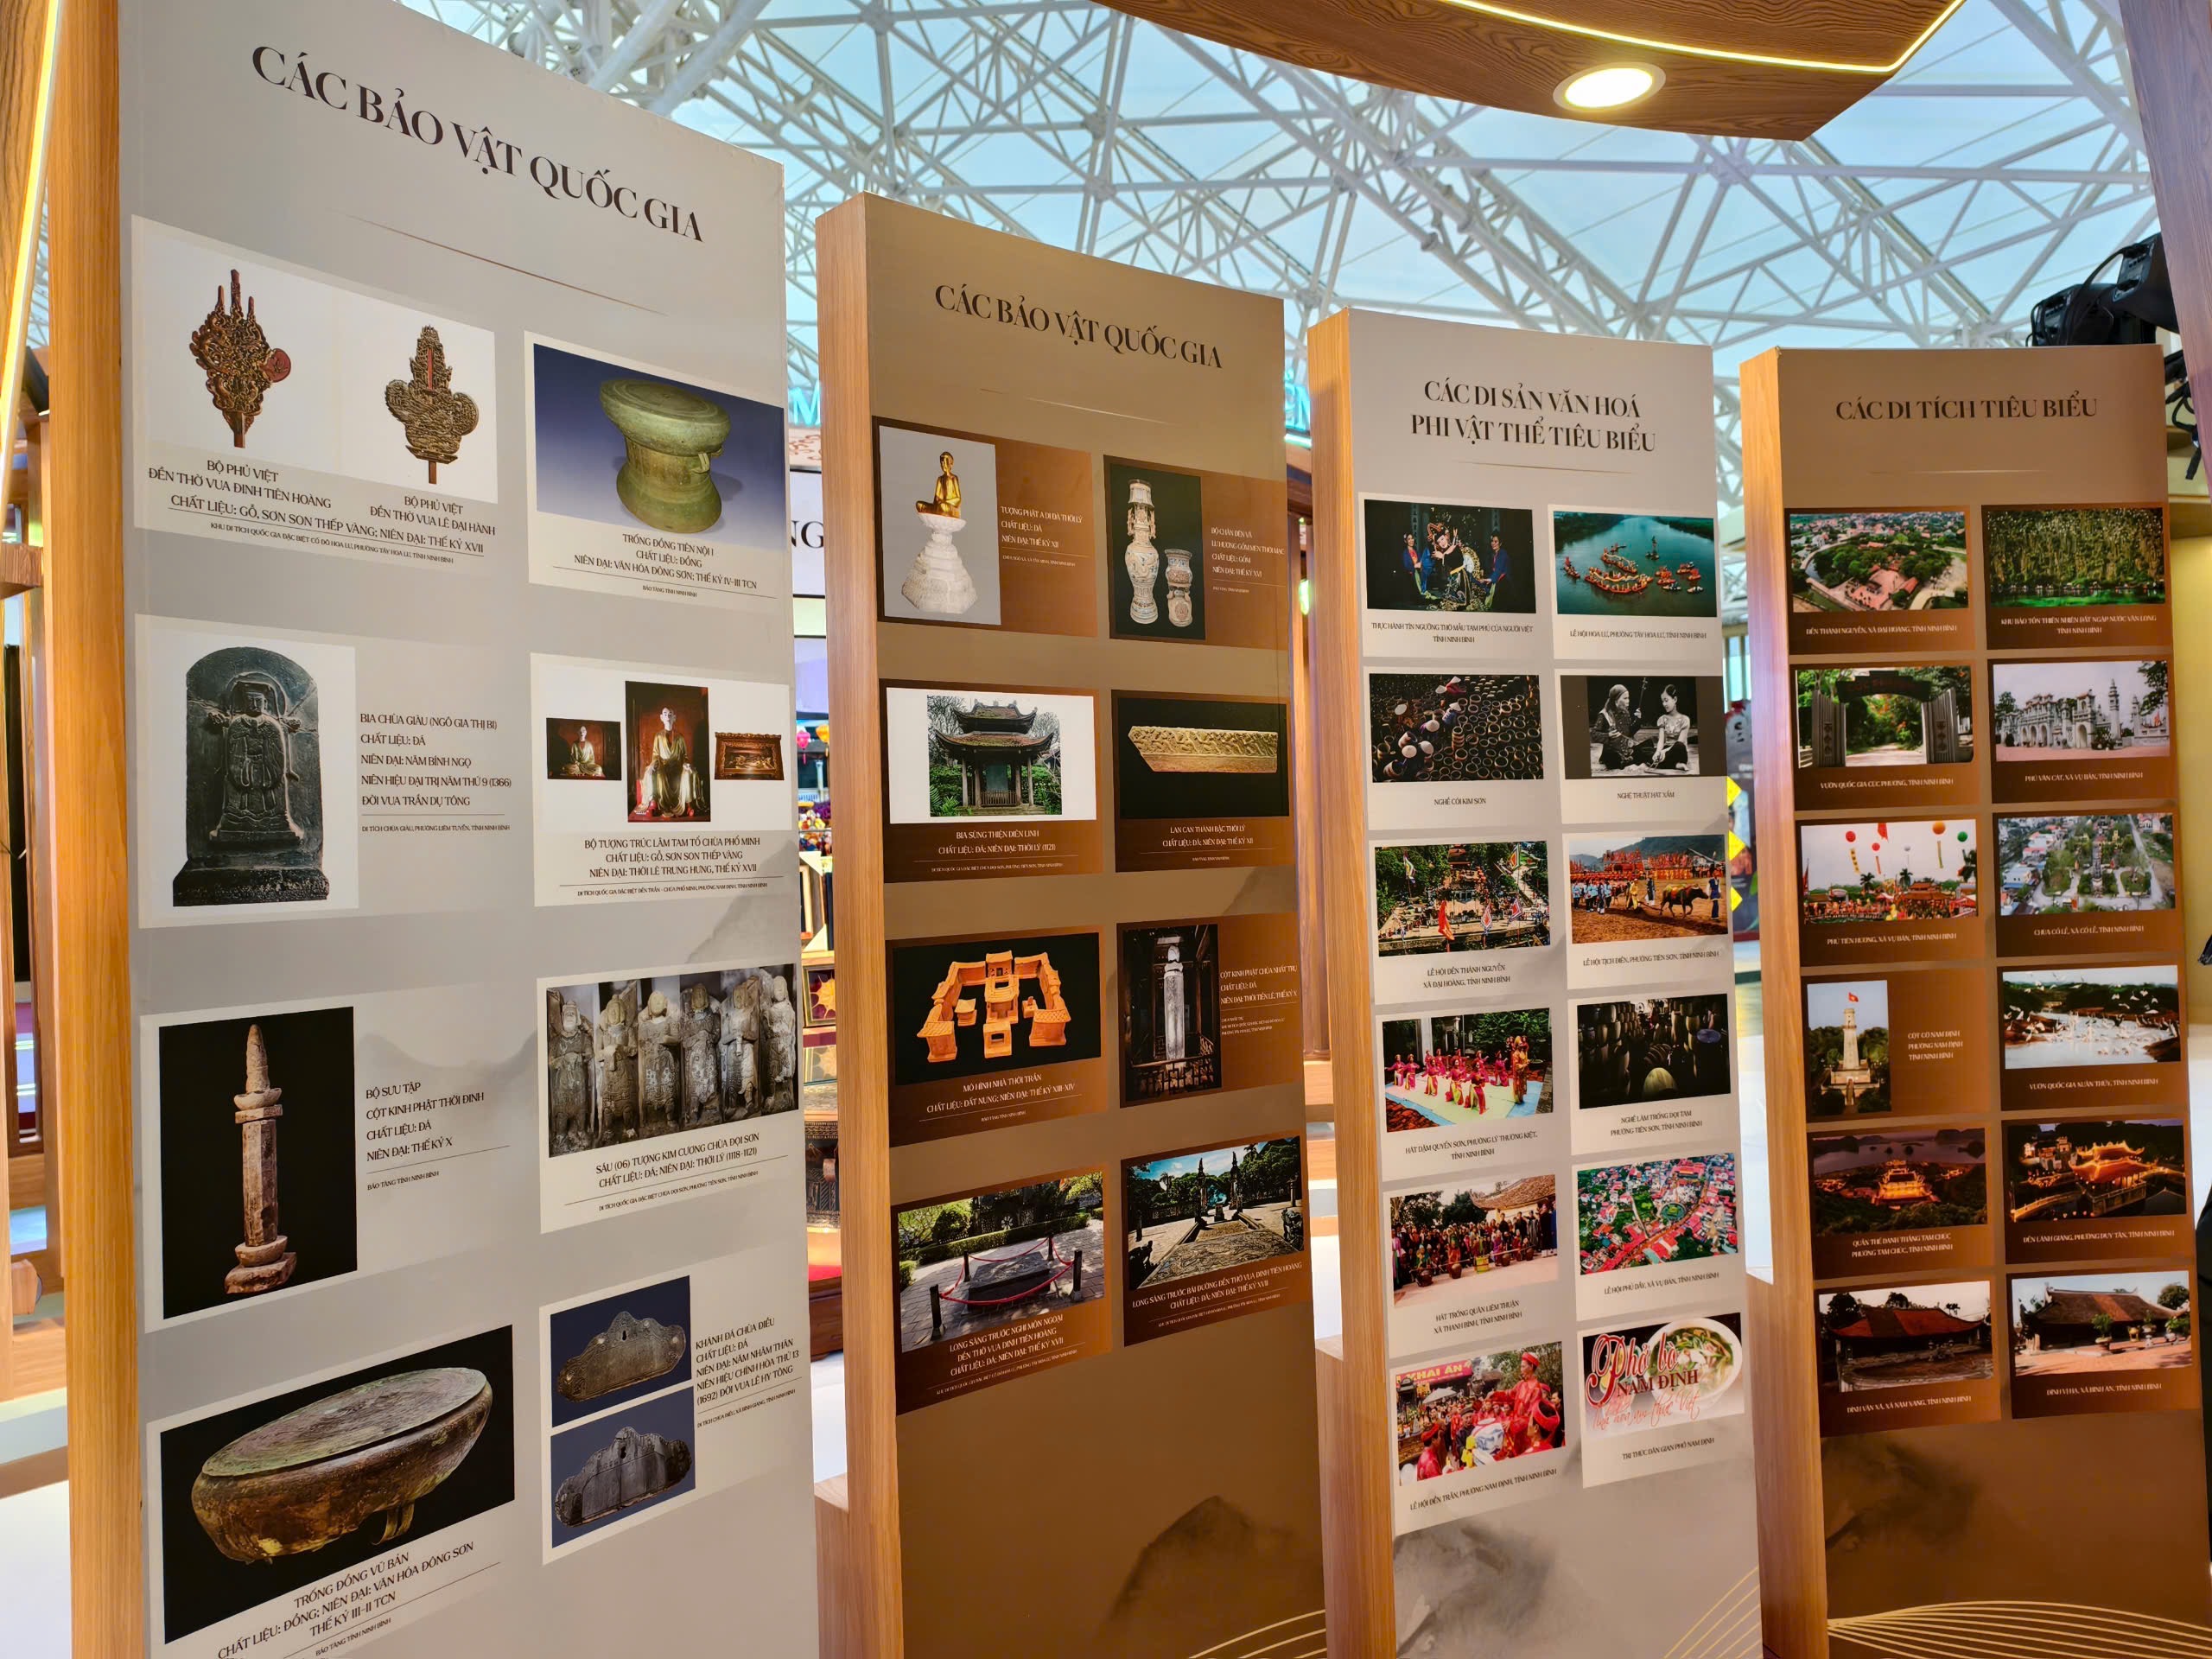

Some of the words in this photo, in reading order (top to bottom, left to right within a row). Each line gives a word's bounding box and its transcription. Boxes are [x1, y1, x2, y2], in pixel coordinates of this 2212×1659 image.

[252, 47, 347, 110] CÁC
[357, 85, 443, 145] BẢO
[450, 122, 522, 175] VẬT
[530, 156, 638, 219] QUỐC
[644, 198, 702, 242] GIA
[935, 283, 991, 319] CÁC
[996, 295, 1050, 331] BẢO
[1054, 310, 1099, 345] VẬT
[1104, 325, 1177, 359] QUỐC
[1180, 340, 1222, 368] GIA
[1425, 378, 1470, 404] CÁC
[1475, 386, 1496, 406] DI
[1502, 383, 1542, 410] SẢN
[1548, 390, 1589, 413] VĂN
[1595, 394, 1640, 418] HOÁ
[1836, 397, 1883, 420] CÁC
[1888, 401, 1910, 419] DI
[1916, 396, 1975, 419] TÍCH
[1980, 395, 2037, 418] TIÊU
[2044, 390, 2096, 417] BIỂU
[1412, 415, 1449, 436] PHI
[1455, 415, 1494, 445] VẬT
[1498, 416, 1545, 444] THỂ
[1548, 423, 1600, 448] TIÊU
[1606, 423, 1655, 452] BIỂU
[207, 460, 225, 474] BỘ
[226, 464, 251, 477] PHỦ
[252, 468, 279, 483] VIỆT
[176, 473, 203, 486] THỜ
[206, 477, 231, 492] VUA
[233, 482, 262, 497] ĐINH
[264, 487, 289, 502] TIÊN
[292, 493, 331, 508] HOÀNG
[404, 496, 419, 509] BỘ
[420, 499, 440, 511] PHỦ
[442, 503, 463, 515] VIỆT
[171, 494, 205, 510] CHẤT
[207, 500, 237, 515] LIỆU:
[239, 504, 259, 519] GỖ,
[262, 510, 286, 522] SƠN
[289, 514, 312, 526] SON
[315, 518, 344, 531] THẾP
[346, 522, 378, 537] VÀNG;
[380, 528, 404, 541] NIÊN
[407, 532, 426, 544] ĐẠI:
[428, 536, 448, 548] THẾ
[449, 538, 462, 550] KỶ
[465, 541, 483, 553] XVII
[416, 513, 436, 526] VUA
[438, 517, 449, 529] LÊ
[452, 519, 467, 531] ĐẠI
[468, 522, 495, 536] HÀNH
[636, 550, 658, 561] CHẤT
[658, 553, 678, 564] LIỆU:
[677, 542, 695, 553] TIÊN
[360, 713, 377, 723] BIA
[378, 714, 404, 724] CHÙA
[454, 719, 469, 728] GIA
[470, 719, 486, 730] THỊ
[360, 732, 387, 744] CHẤT
[388, 734, 410, 746] LIỆU:
[412, 734, 426, 746] ĐÁ
[366, 1086, 380, 1099] BỘ
[381, 1085, 401, 1096] SƯU
[402, 1081, 421, 1094] TẬP
[366, 1107, 387, 1120] CỘT
[388, 1103, 411, 1116] KINH
[413, 1099, 437, 1112] PHẬT
[438, 1095, 461, 1108] THỜI
[462, 1092, 484, 1104] ĐINH
[596, 1162, 613, 1174] SÁU
[614, 1160, 631, 1171] (06)
[632, 1153, 661, 1166] TƯỢNG
[662, 1149, 677, 1160] KIM
[707, 1139, 728, 1151] CHÙA
[729, 1136, 743, 1147] ĐỌI
[744, 1133, 760, 1143] SƠN
[696, 1334, 723, 1350] KHÁNH
[1586, 1334, 1650, 1408] Phở
[1658, 1332, 1678, 1372] bò
[1618, 1375, 1654, 1397] NAM
[1659, 1370, 1698, 1391] ĐỊNH
[309, 1615, 333, 1637] THẾ
[334, 1609, 349, 1627] KỶ
[373, 1591, 396, 1608] TCN
